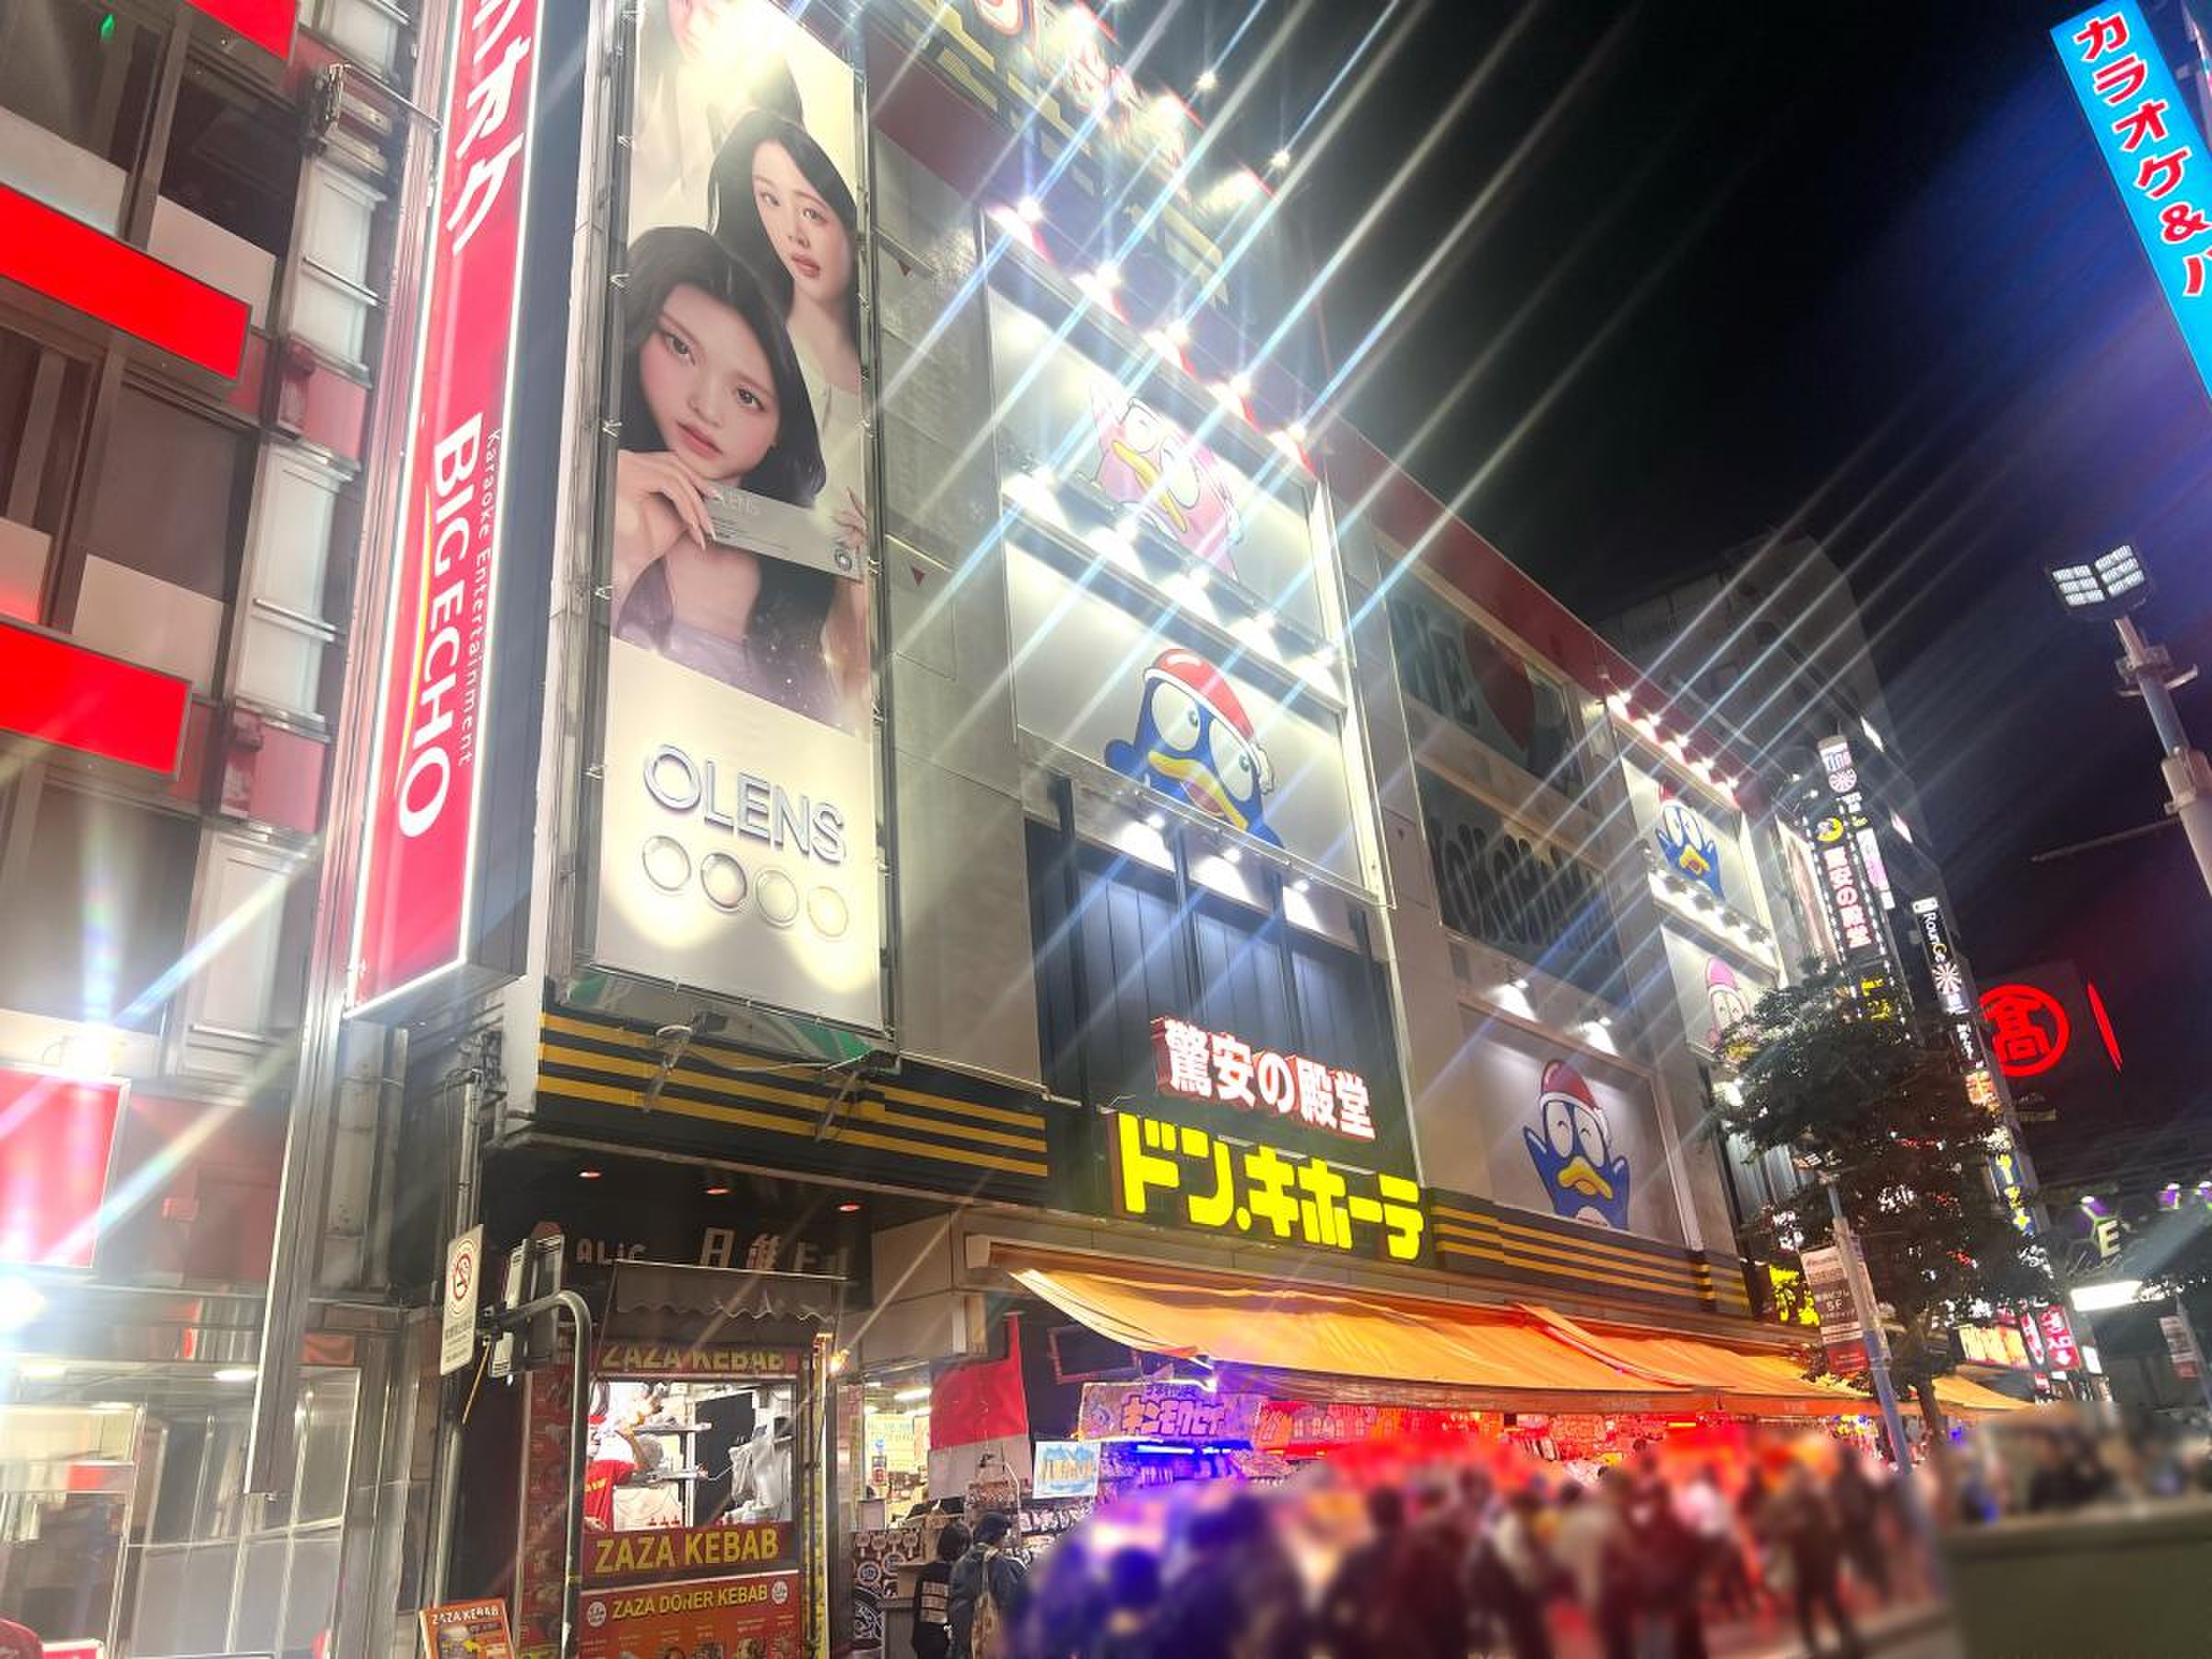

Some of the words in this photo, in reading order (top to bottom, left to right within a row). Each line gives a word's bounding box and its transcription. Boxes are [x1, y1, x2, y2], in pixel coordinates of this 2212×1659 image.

[434, 412, 483, 579] BIG
[477, 428, 501, 537] Karaoke
[399, 586, 464, 837] ECHO
[457, 548, 491, 767] Entertainment
[643, 744, 846, 864] OLENS
[1164, 1017, 1376, 1140] 驚安の殿堂
[603, 1345, 680, 1372] ZAZA
[595, 1536, 676, 1573] ZAZA
[685, 1528, 779, 1566] KEBAB
[612, 1598, 656, 1620] ZAZA
[718, 1584, 768, 1608] KEBAB
